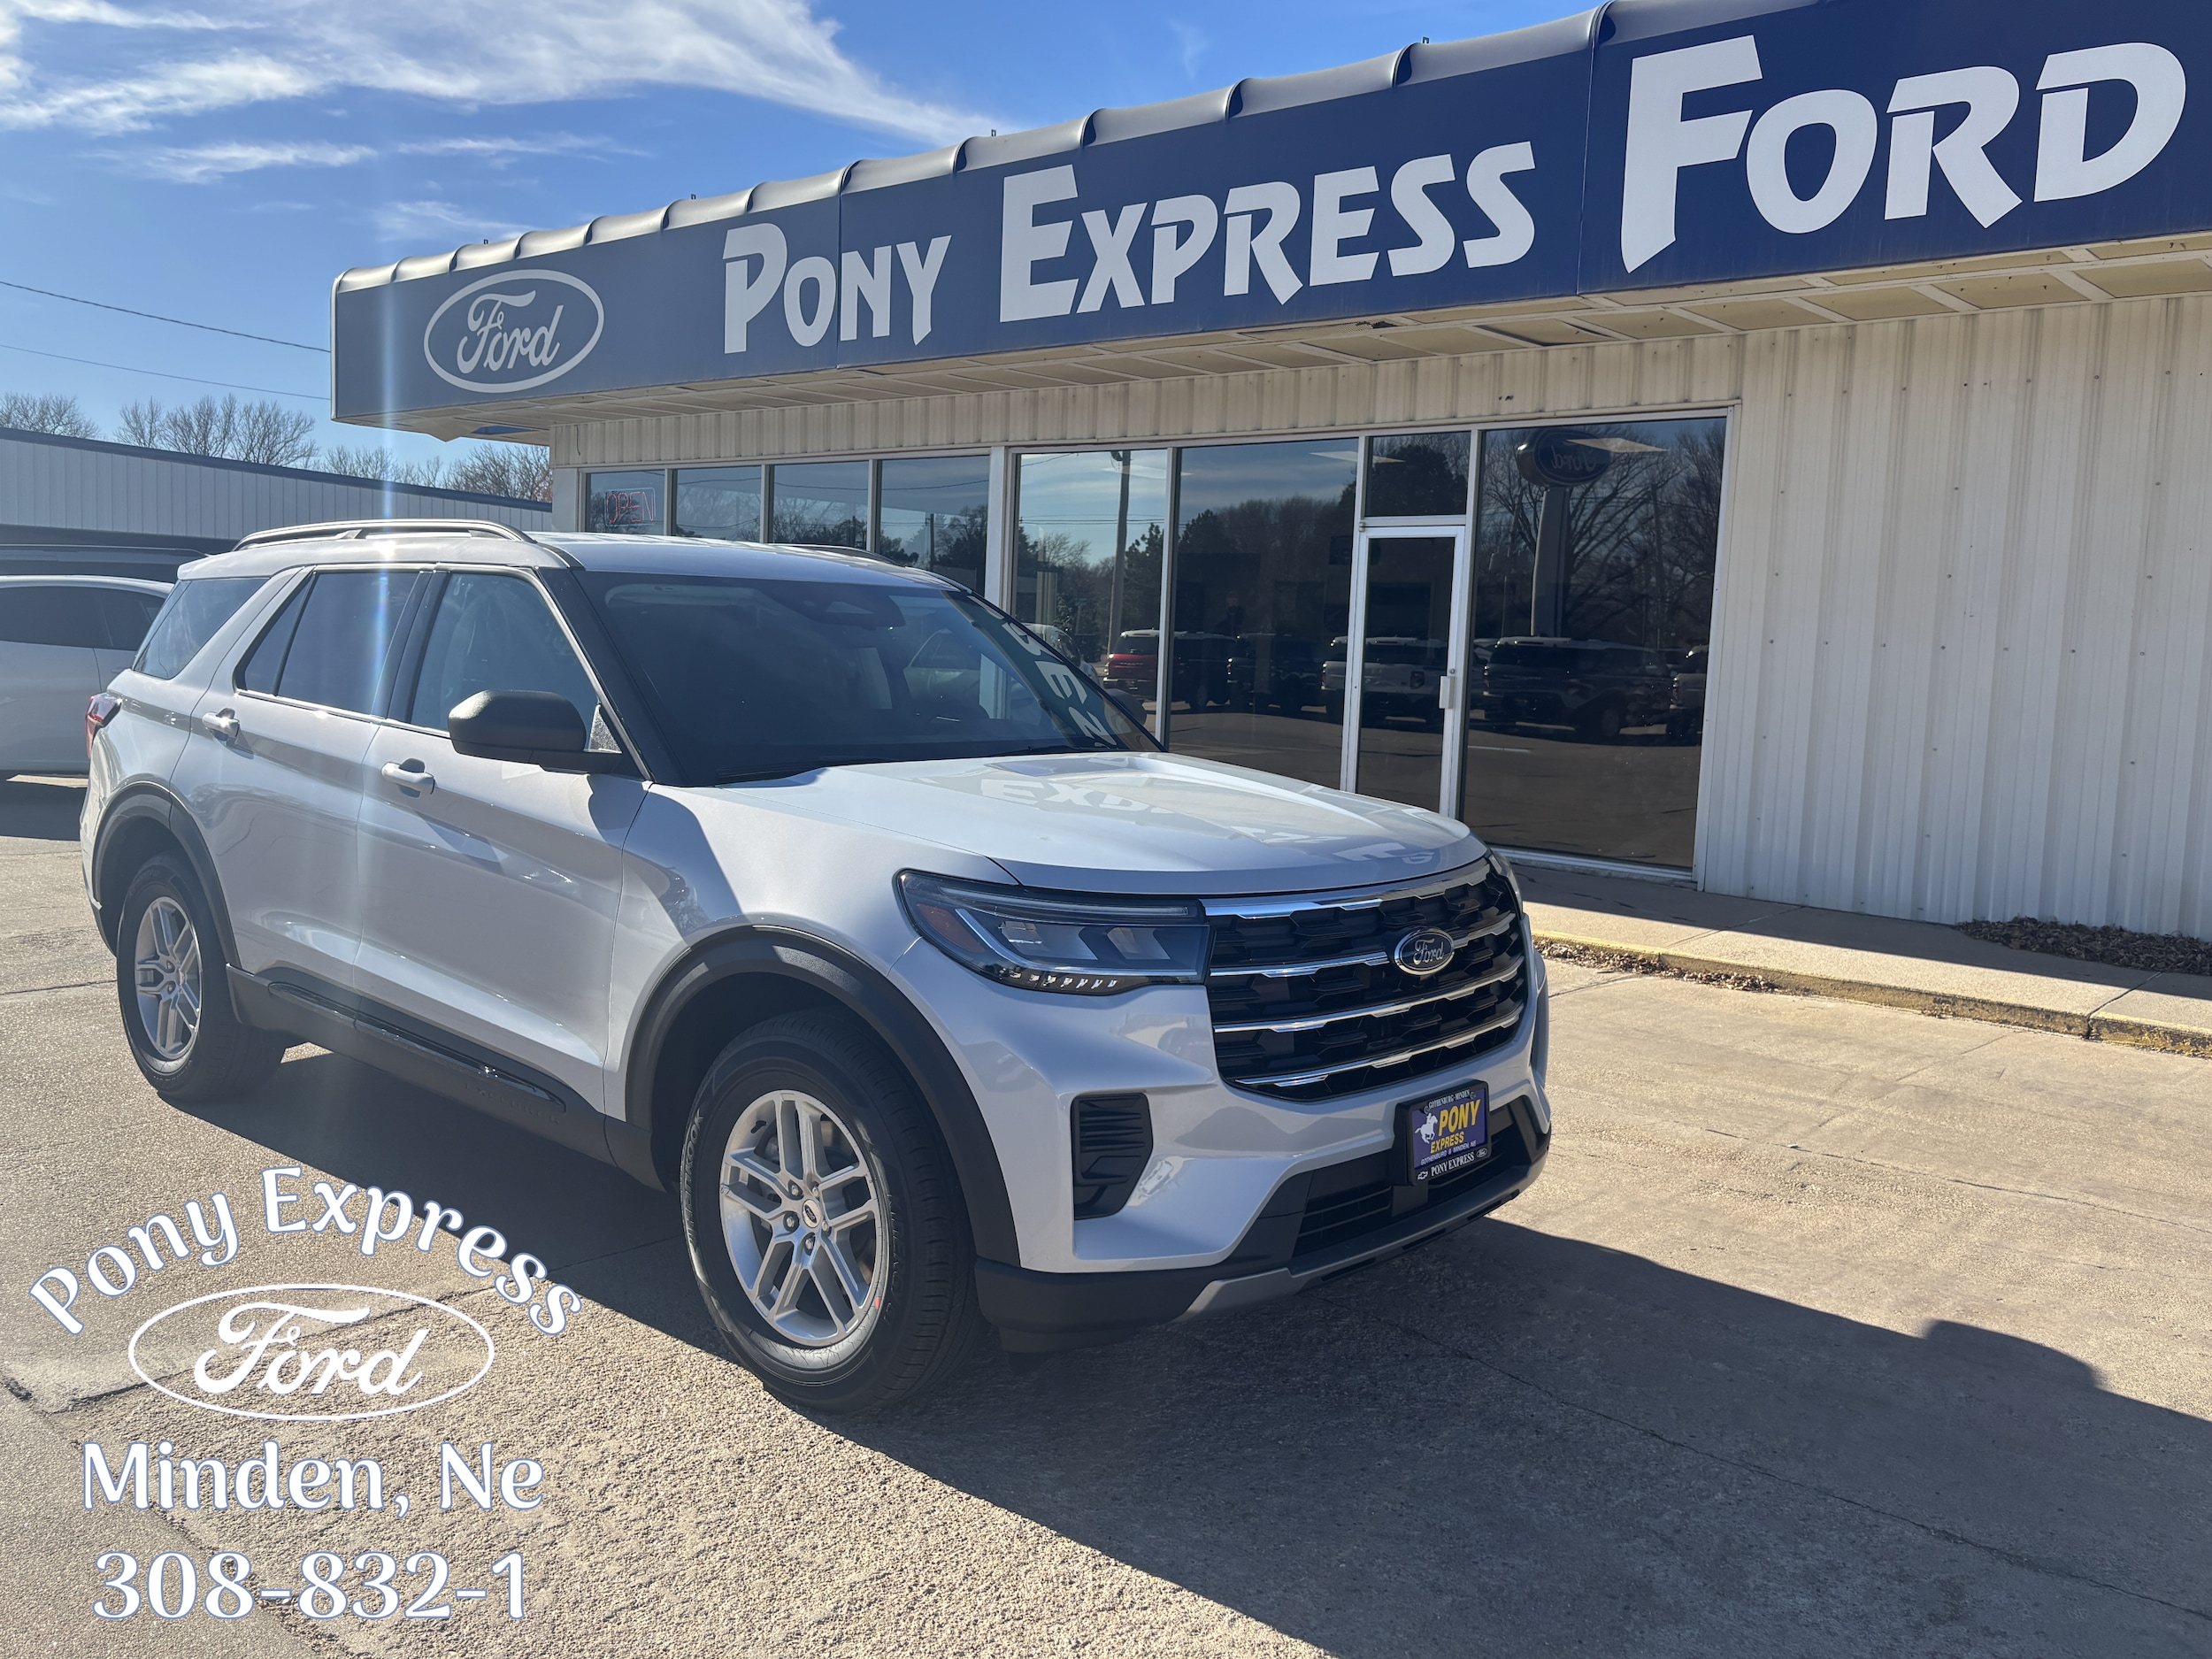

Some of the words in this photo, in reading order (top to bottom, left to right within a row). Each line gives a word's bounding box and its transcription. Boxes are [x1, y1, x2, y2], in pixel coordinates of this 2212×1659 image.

[723, 222, 952, 354] PONY
[999, 140, 1536, 323] EXPRESS
[1619, 35, 2186, 273] FORD
[457, 290, 564, 374] Ford
[606, 490, 654, 524] OPEN
[1413, 938, 1445, 965] Ford
[1439, 1099, 1481, 1137] PONY
[1430, 1132, 1464, 1154] EXPRESS
[1431, 1161, 1448, 1177] PONY
[1448, 1152, 1475, 1170] EXPRESS
